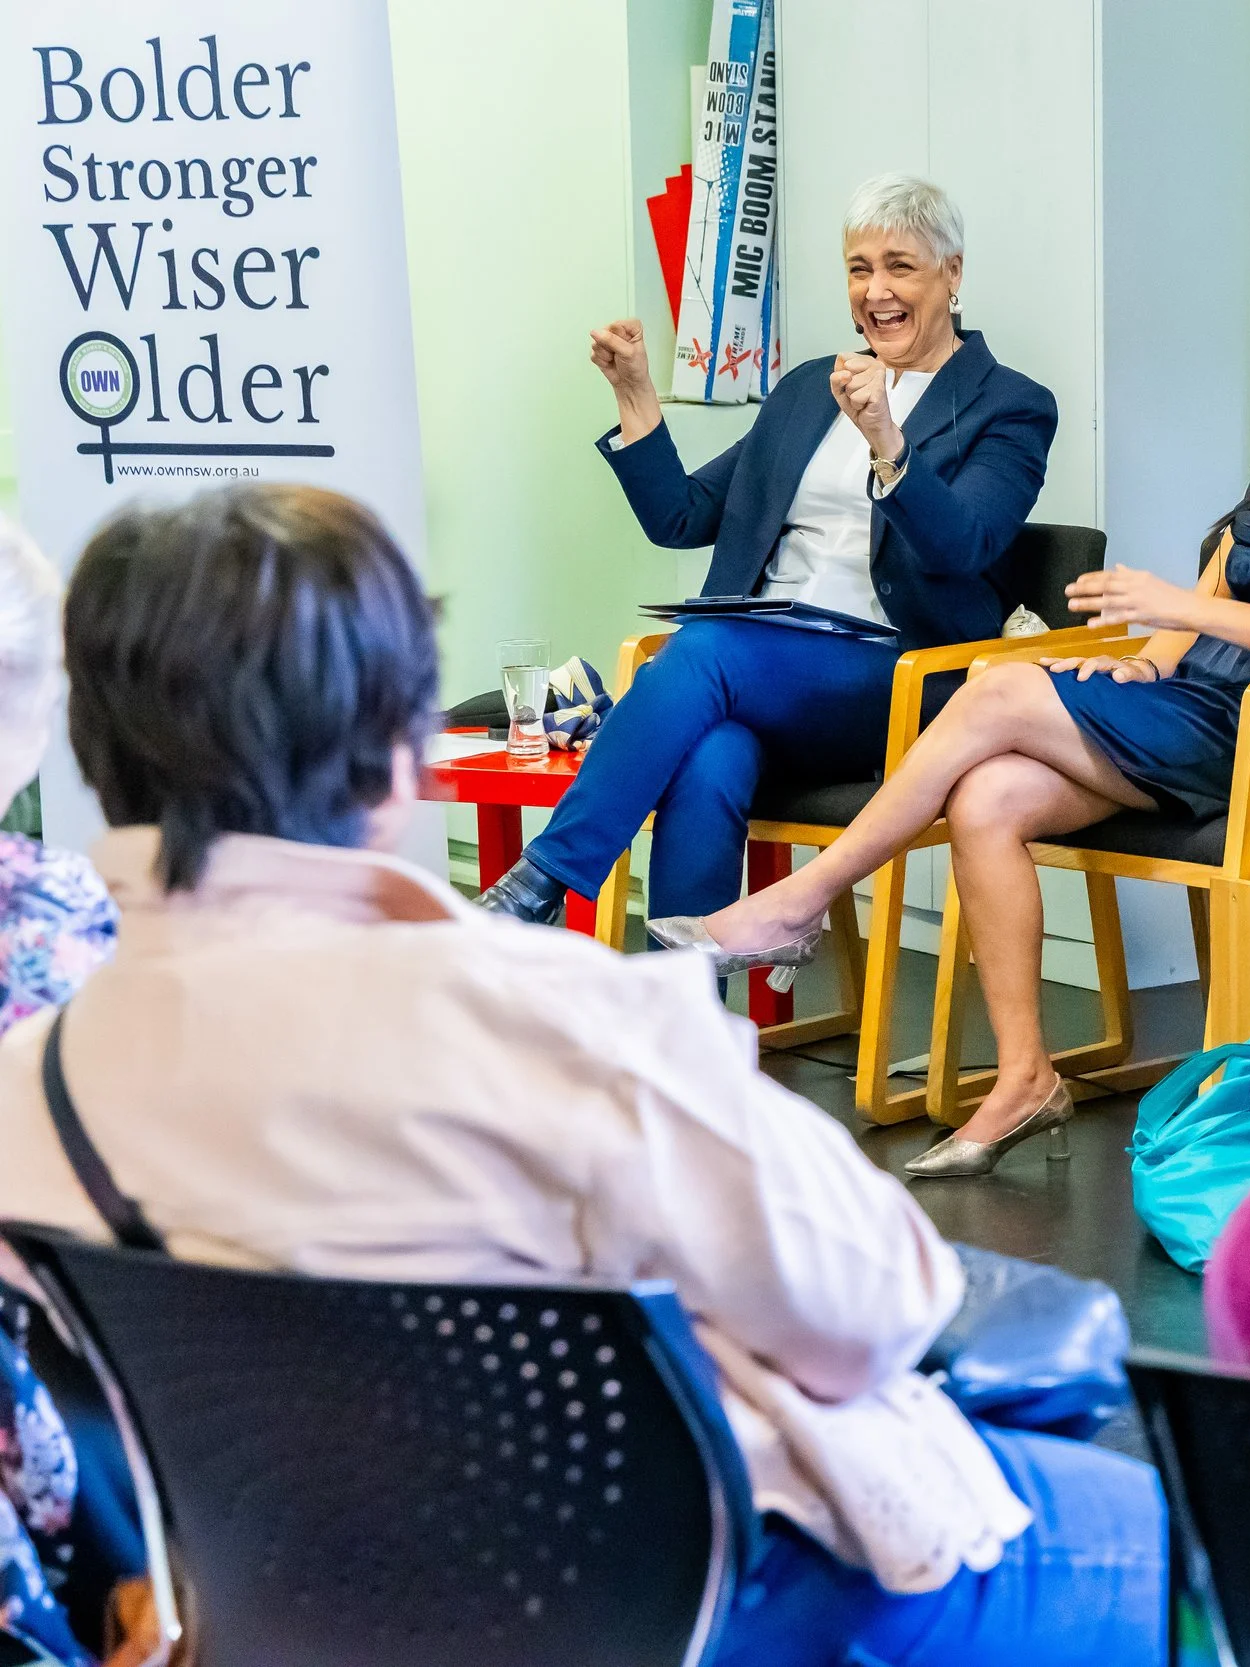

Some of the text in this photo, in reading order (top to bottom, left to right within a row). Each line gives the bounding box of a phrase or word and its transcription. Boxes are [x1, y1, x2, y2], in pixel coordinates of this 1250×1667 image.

[32, 35, 311, 125] Bolder
[710, 62, 748, 85] STAND
[707, 91, 745, 116] BOOM
[704, 121, 740, 145] MIC
[42, 145, 318, 218] Stronger
[739, 154, 777, 237] BOOM
[42, 219, 320, 312] Wiser
[731, 244, 764, 299] MIC
[80, 370, 120, 392] OWN
[117, 466, 259, 479] www.ownnsw.org.au
